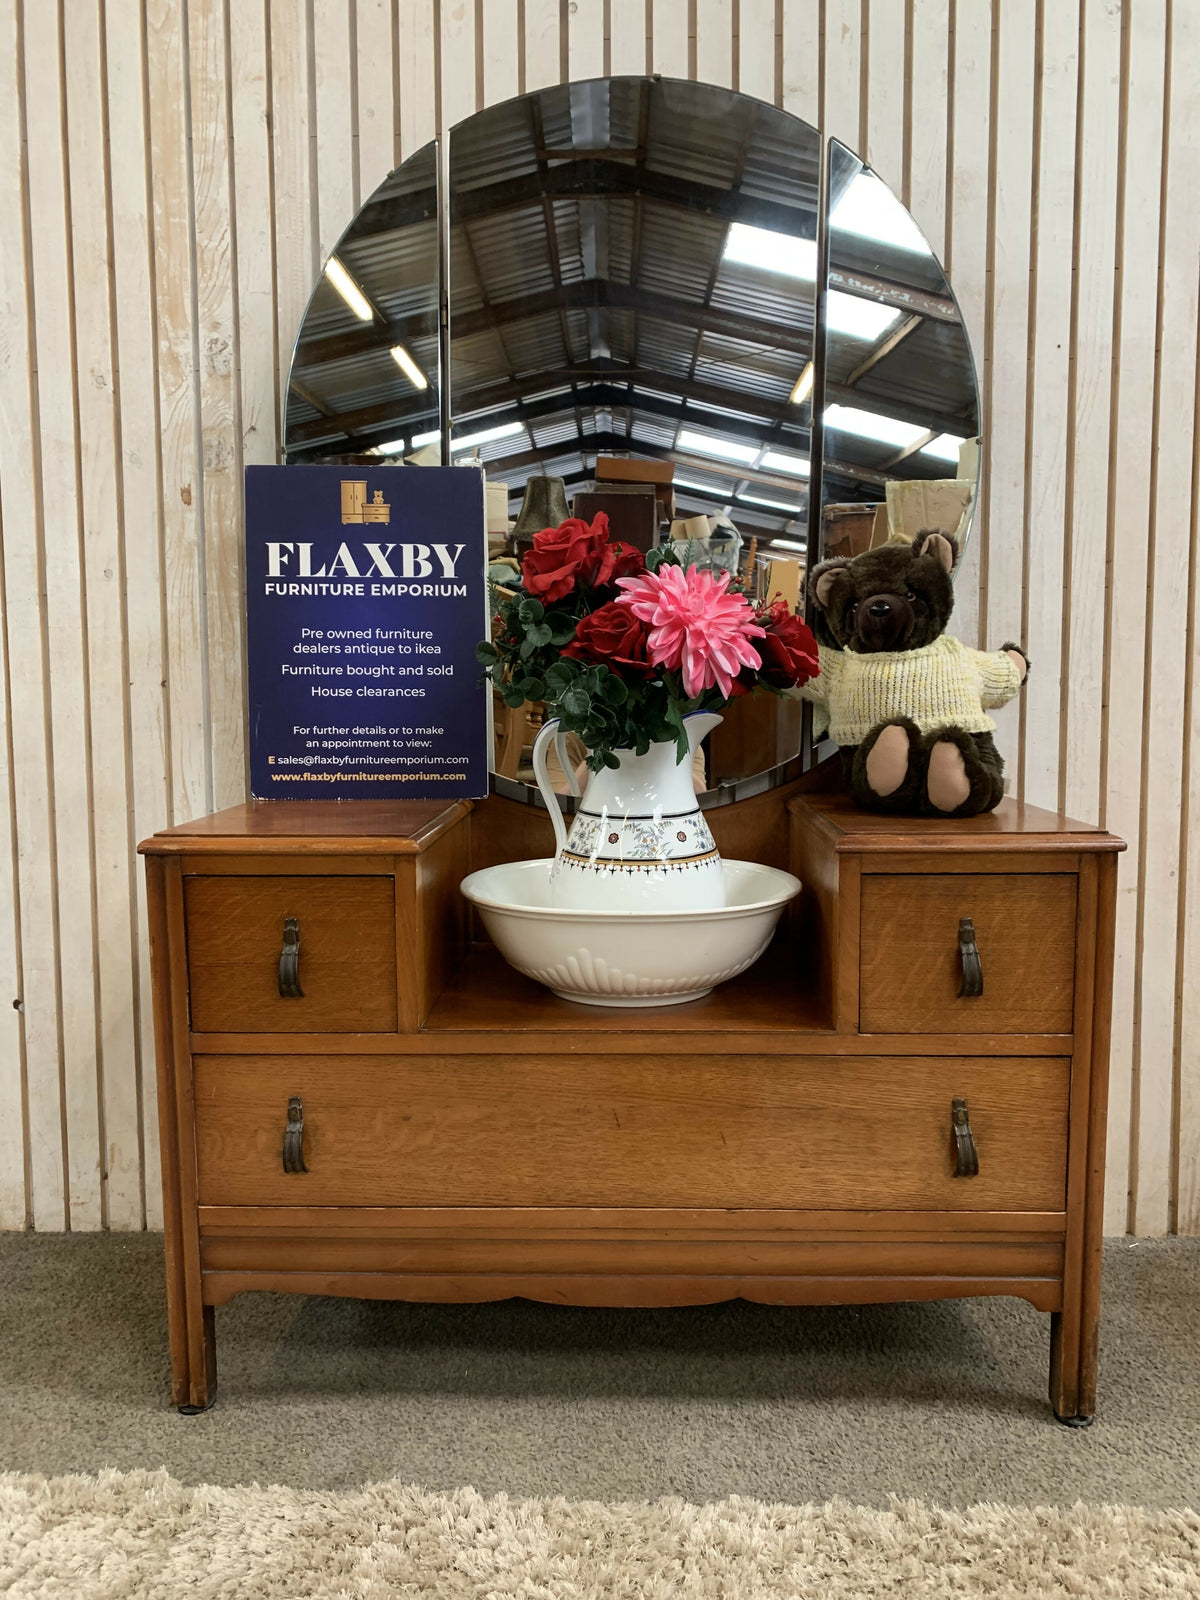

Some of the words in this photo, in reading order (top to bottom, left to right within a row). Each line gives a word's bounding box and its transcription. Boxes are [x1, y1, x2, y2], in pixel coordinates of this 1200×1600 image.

[265, 542, 466, 578] FLAXBY
[265, 582, 365, 596] FURNITURE
[370, 583, 467, 597] EMPORIUM
[301, 627, 324, 639] Pre
[326, 628, 372, 639] owned
[374, 627, 434, 640] furniture
[292, 642, 342, 654] dealers
[344, 642, 396, 657] antique
[397, 644, 412, 654] to
[415, 642, 441, 655] ikea
[281, 663, 344, 676] Furniture
[346, 664, 396, 678] bought
[398, 664, 424, 676] and
[426, 664, 454, 676] sold
[311, 686, 353, 697] House
[356, 685, 426, 697] clearances
[293, 725, 311, 735] For
[312, 725, 350, 735] further
[351, 725, 387, 735] details
[388, 727, 400, 735] or
[401, 726, 413, 735] to
[415, 725, 445, 735] make
[305, 740, 320, 748] an
[321, 738, 391, 750] appointment
[392, 739, 404, 748] to
[405, 738, 432, 748] view:
[268, 755, 276, 765] E
[277, 754, 469, 767] sales@flaxbyfurnitureemporium.com
[270, 771, 467, 783] www.flaxbyfurnitureemporium.com
